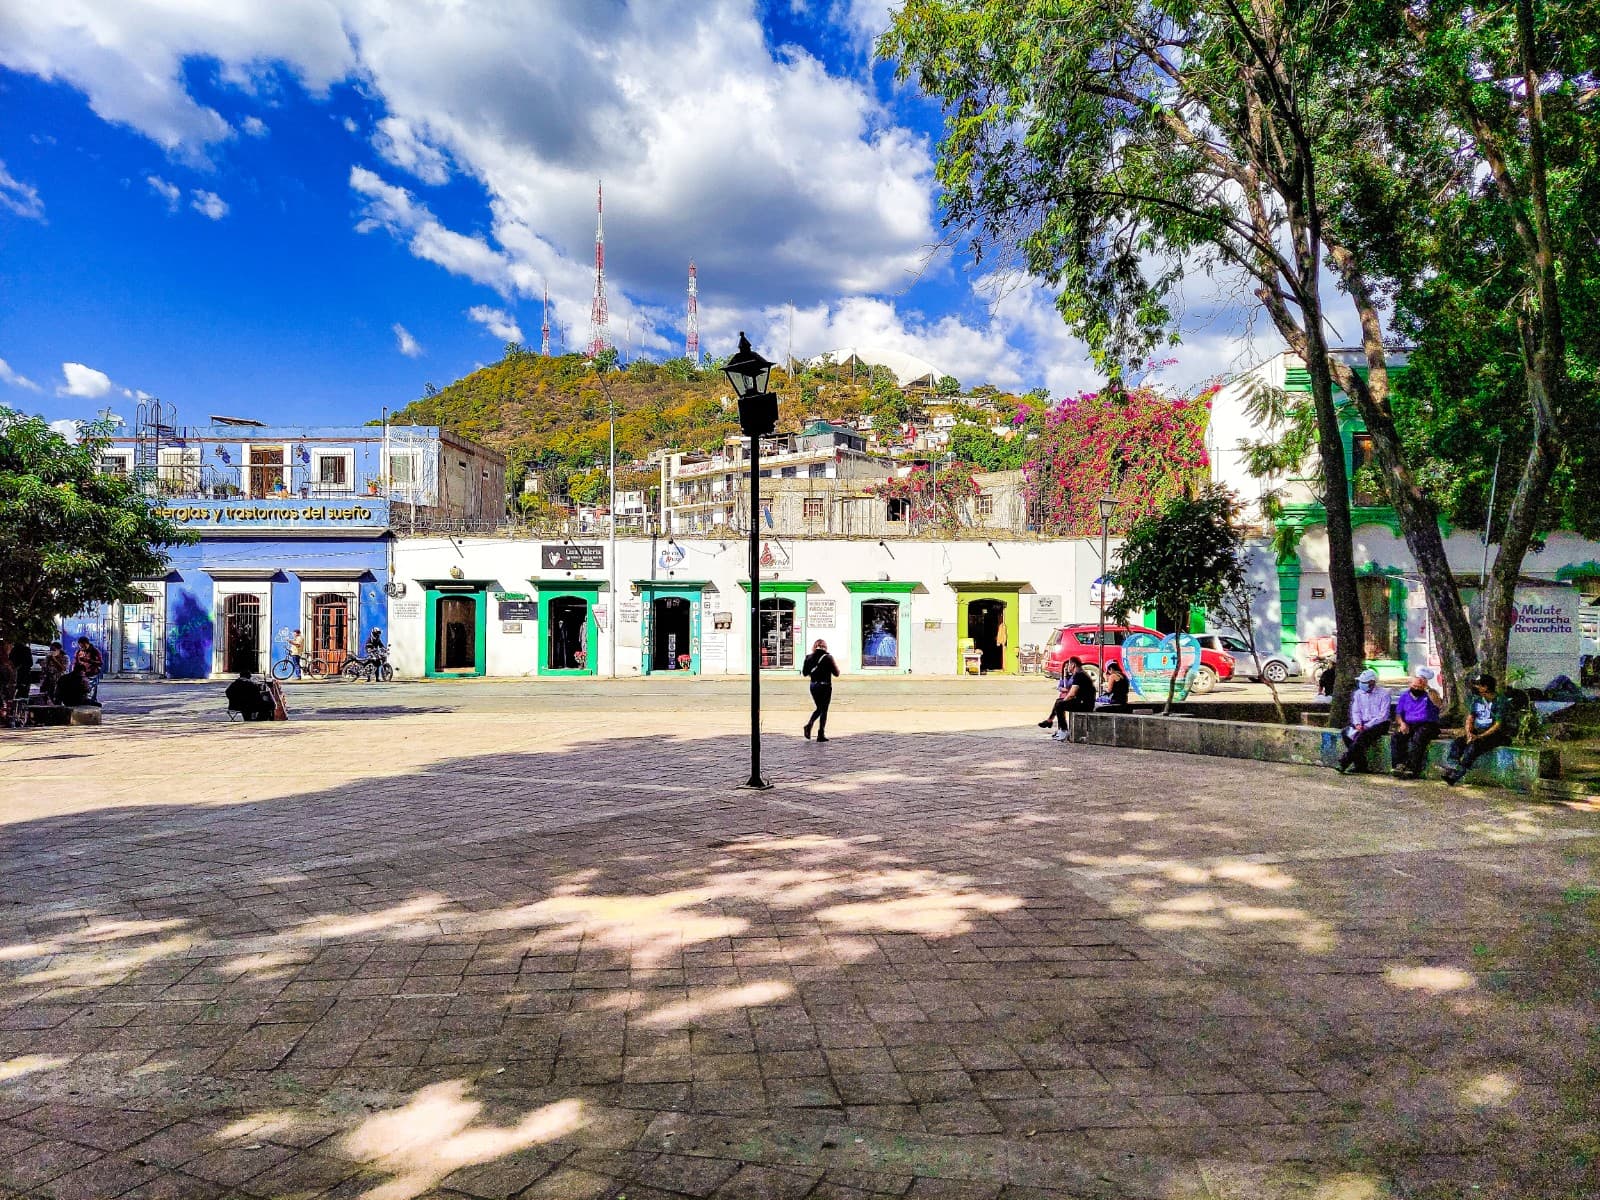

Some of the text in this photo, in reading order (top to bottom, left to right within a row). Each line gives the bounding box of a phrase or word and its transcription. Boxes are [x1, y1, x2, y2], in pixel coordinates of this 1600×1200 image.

[213, 508, 223, 522] y
[226, 506, 299, 520] trastornos
[302, 505, 325, 520] del
[328, 505, 371, 520] sueño
[1521, 604, 1562, 615] Melate
[1518, 615, 1570, 624] Revancha
[1514, 624, 1572, 633] Revanchita
